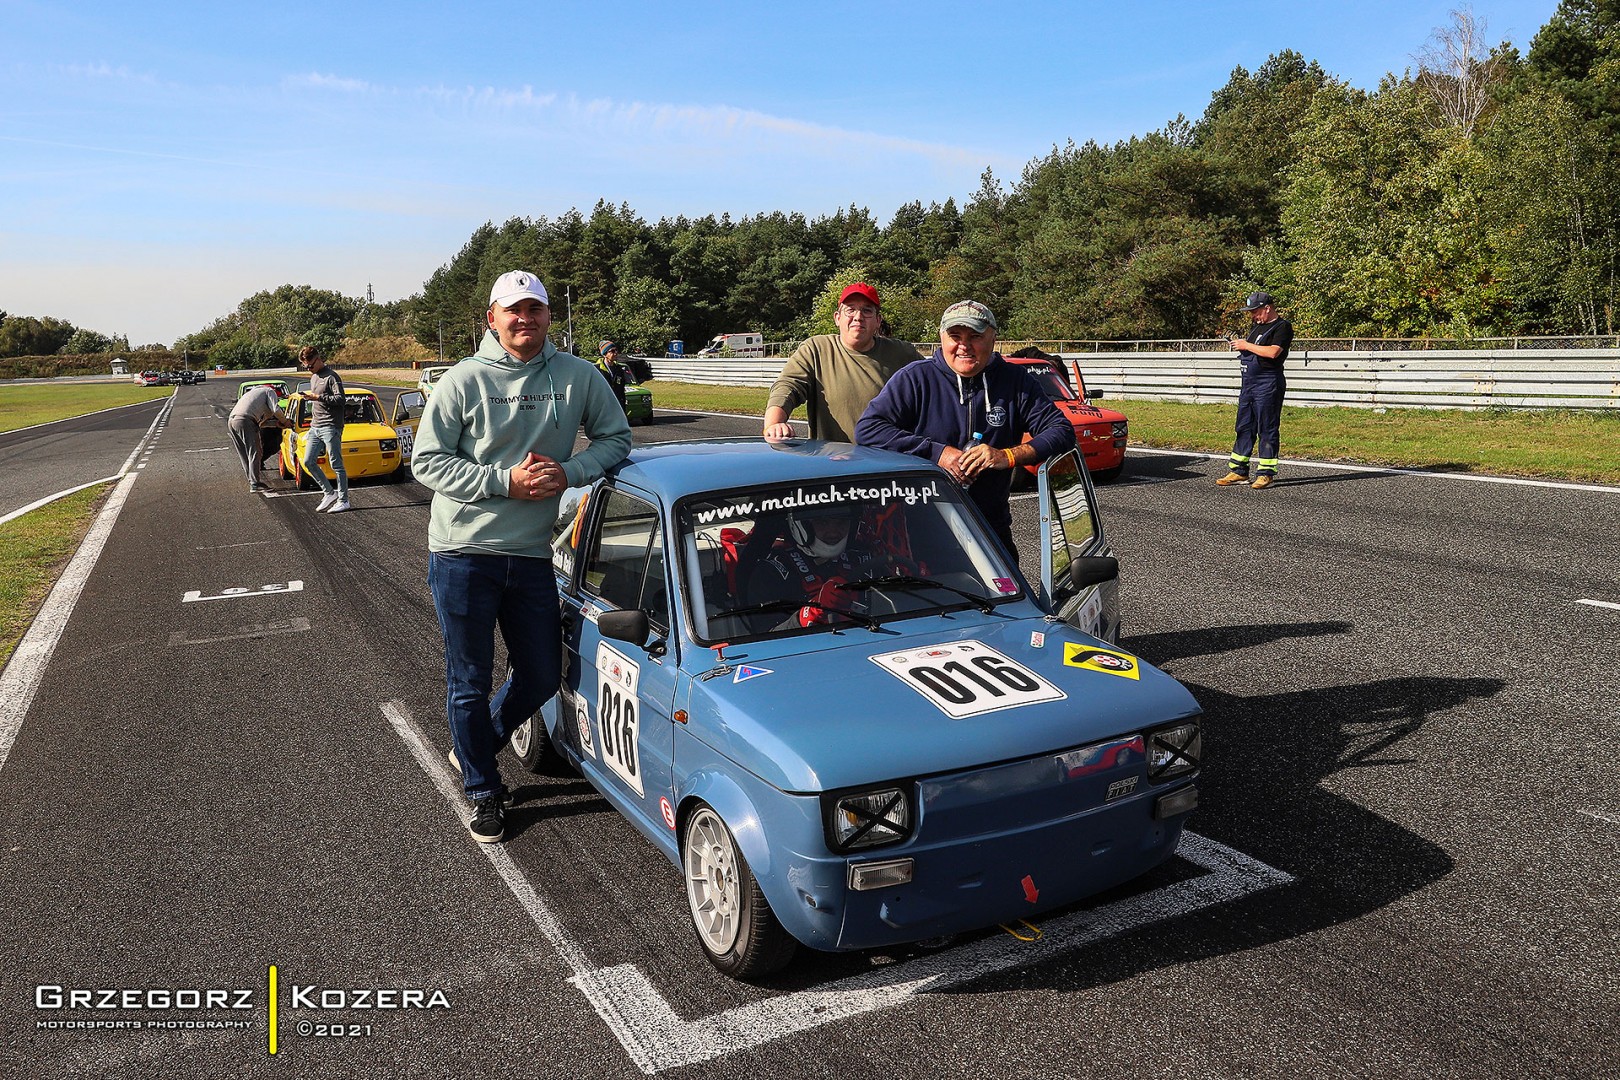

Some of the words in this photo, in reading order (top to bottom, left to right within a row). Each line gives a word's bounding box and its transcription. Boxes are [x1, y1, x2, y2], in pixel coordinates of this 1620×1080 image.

[489, 394, 521, 405] TOMMY
[697, 481, 940, 524] www.maluch-trophy.pl
[908, 655, 1041, 705] 016
[600, 682, 637, 777] 016
[1107, 784, 1135, 800] FIAT
[662, 803, 674, 825] E
